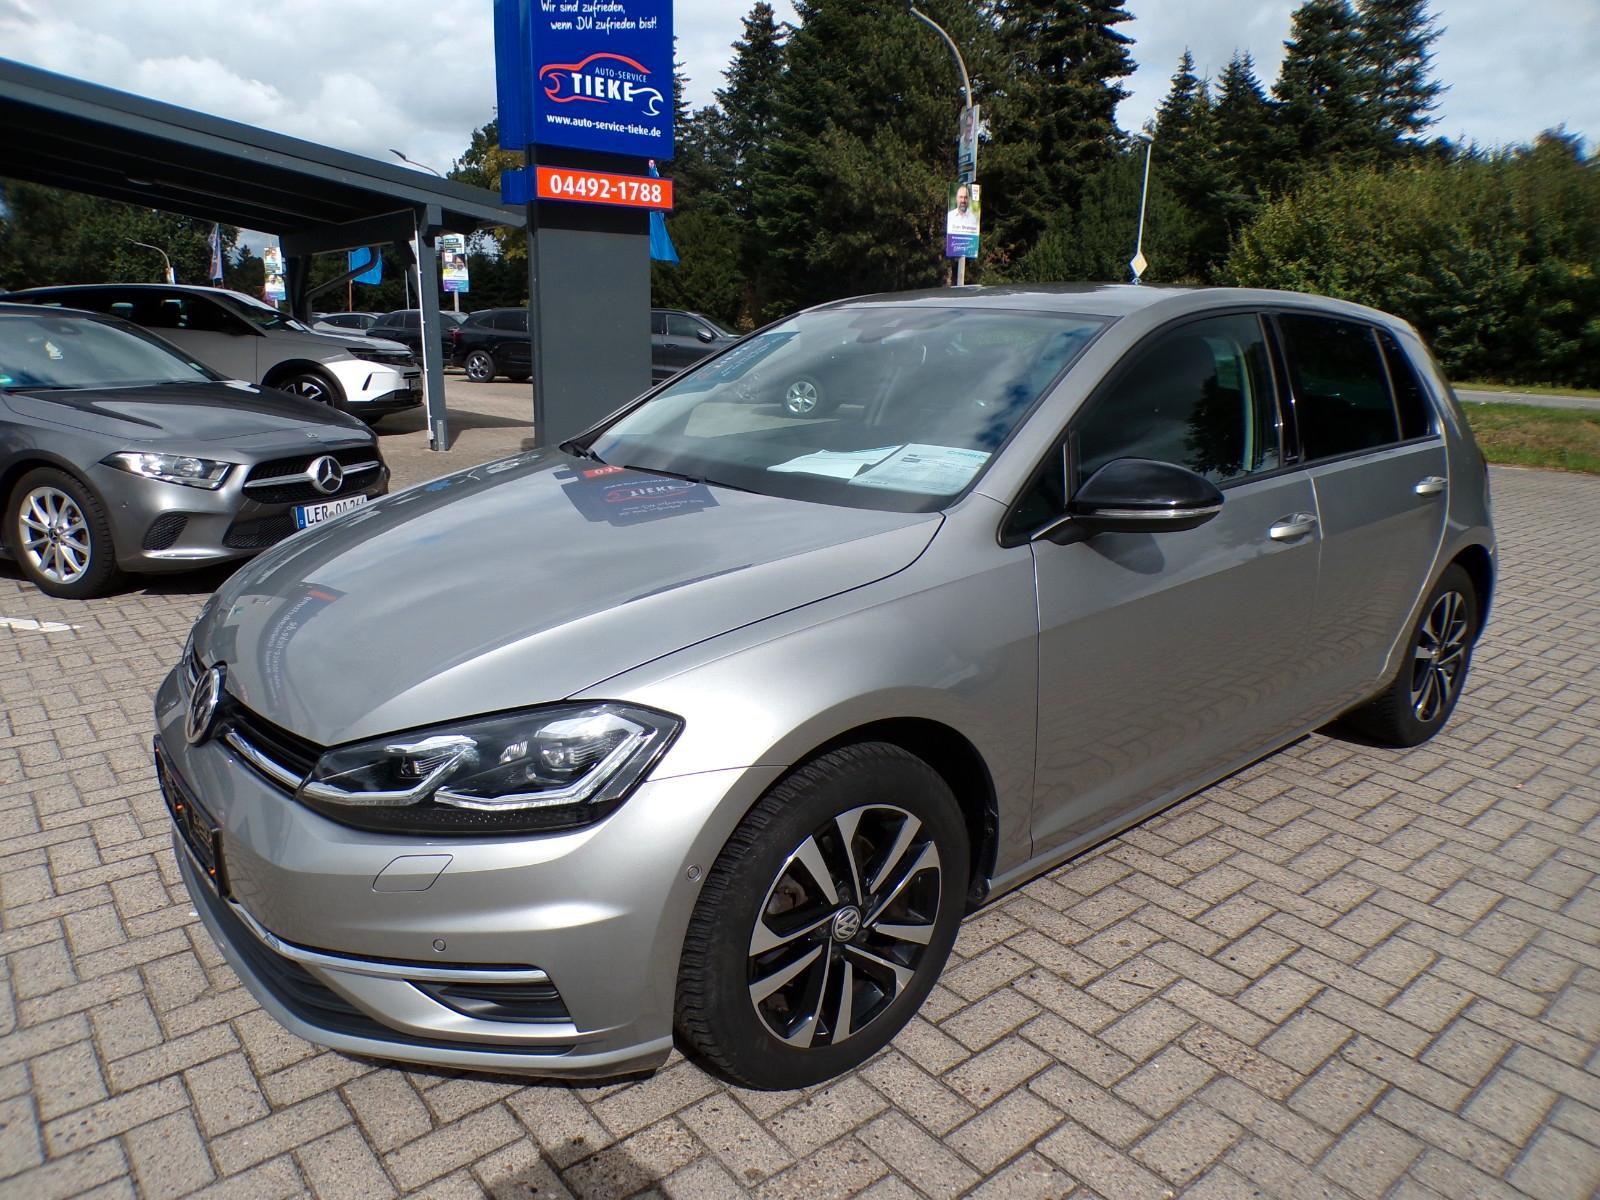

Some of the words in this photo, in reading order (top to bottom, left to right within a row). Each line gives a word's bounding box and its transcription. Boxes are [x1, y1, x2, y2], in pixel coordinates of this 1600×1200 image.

[541, 0, 556, 12] Wir
[560, 0, 578, 12] sind
[582, 0, 626, 17] zufrieden,
[550, 21, 573, 30] wenn
[576, 16, 593, 31] DU
[595, 17, 636, 35] zufrieden
[639, 16, 657, 29] bist!
[594, 66, 647, 83] AUTO-SERVICE
[571, 72, 634, 102] TIEKE
[546, 114, 662, 137] www.auto-service-tieke.de
[550, 174, 662, 202] 04492-1788
[306, 505, 329, 524] LER
